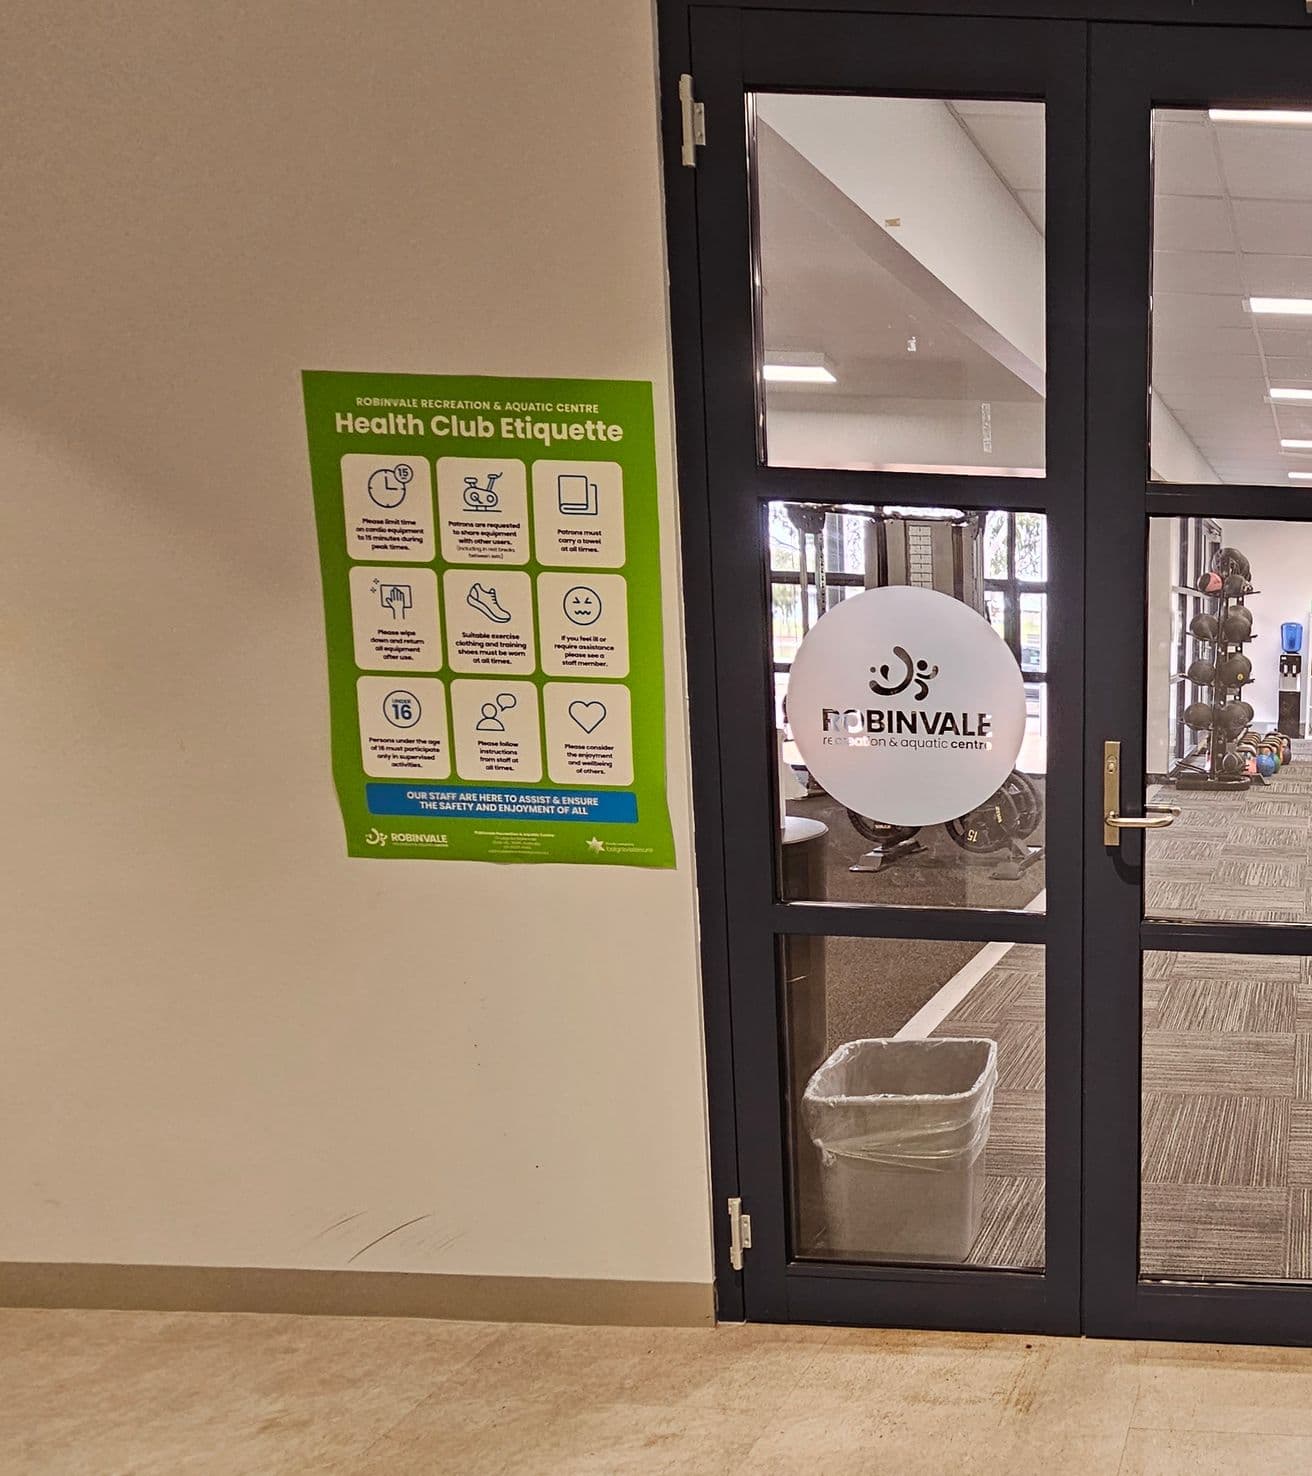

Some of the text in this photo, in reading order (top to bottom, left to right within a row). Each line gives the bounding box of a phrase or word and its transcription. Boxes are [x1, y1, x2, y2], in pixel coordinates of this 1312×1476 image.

[356, 397, 598, 413] ROBINVALE RECREATION & AQUATIC CENTRE
[336, 412, 623, 446] Health Club Etiquette
[398, 468, 408, 477] 15
[401, 536, 423, 544] during
[491, 632, 519, 640] exercise
[456, 640, 484, 649] clothing
[500, 641, 526, 650] training
[555, 643, 577, 651] require
[392, 704, 412, 720] 16
[823, 708, 992, 737] ROBINVALE
[889, 737, 898, 747] &
[901, 738, 948, 750] aquatic
[951, 739, 992, 751] centre
[578, 752, 612, 760] enjoyment
[407, 791, 599, 806] OUR STAFF ARE HERE TO ASSIST & ENSURE
[420, 801, 588, 815] THE SAFETY AND ENJOYMENT OF ALL
[391, 833, 447, 843] ROBINVALE
